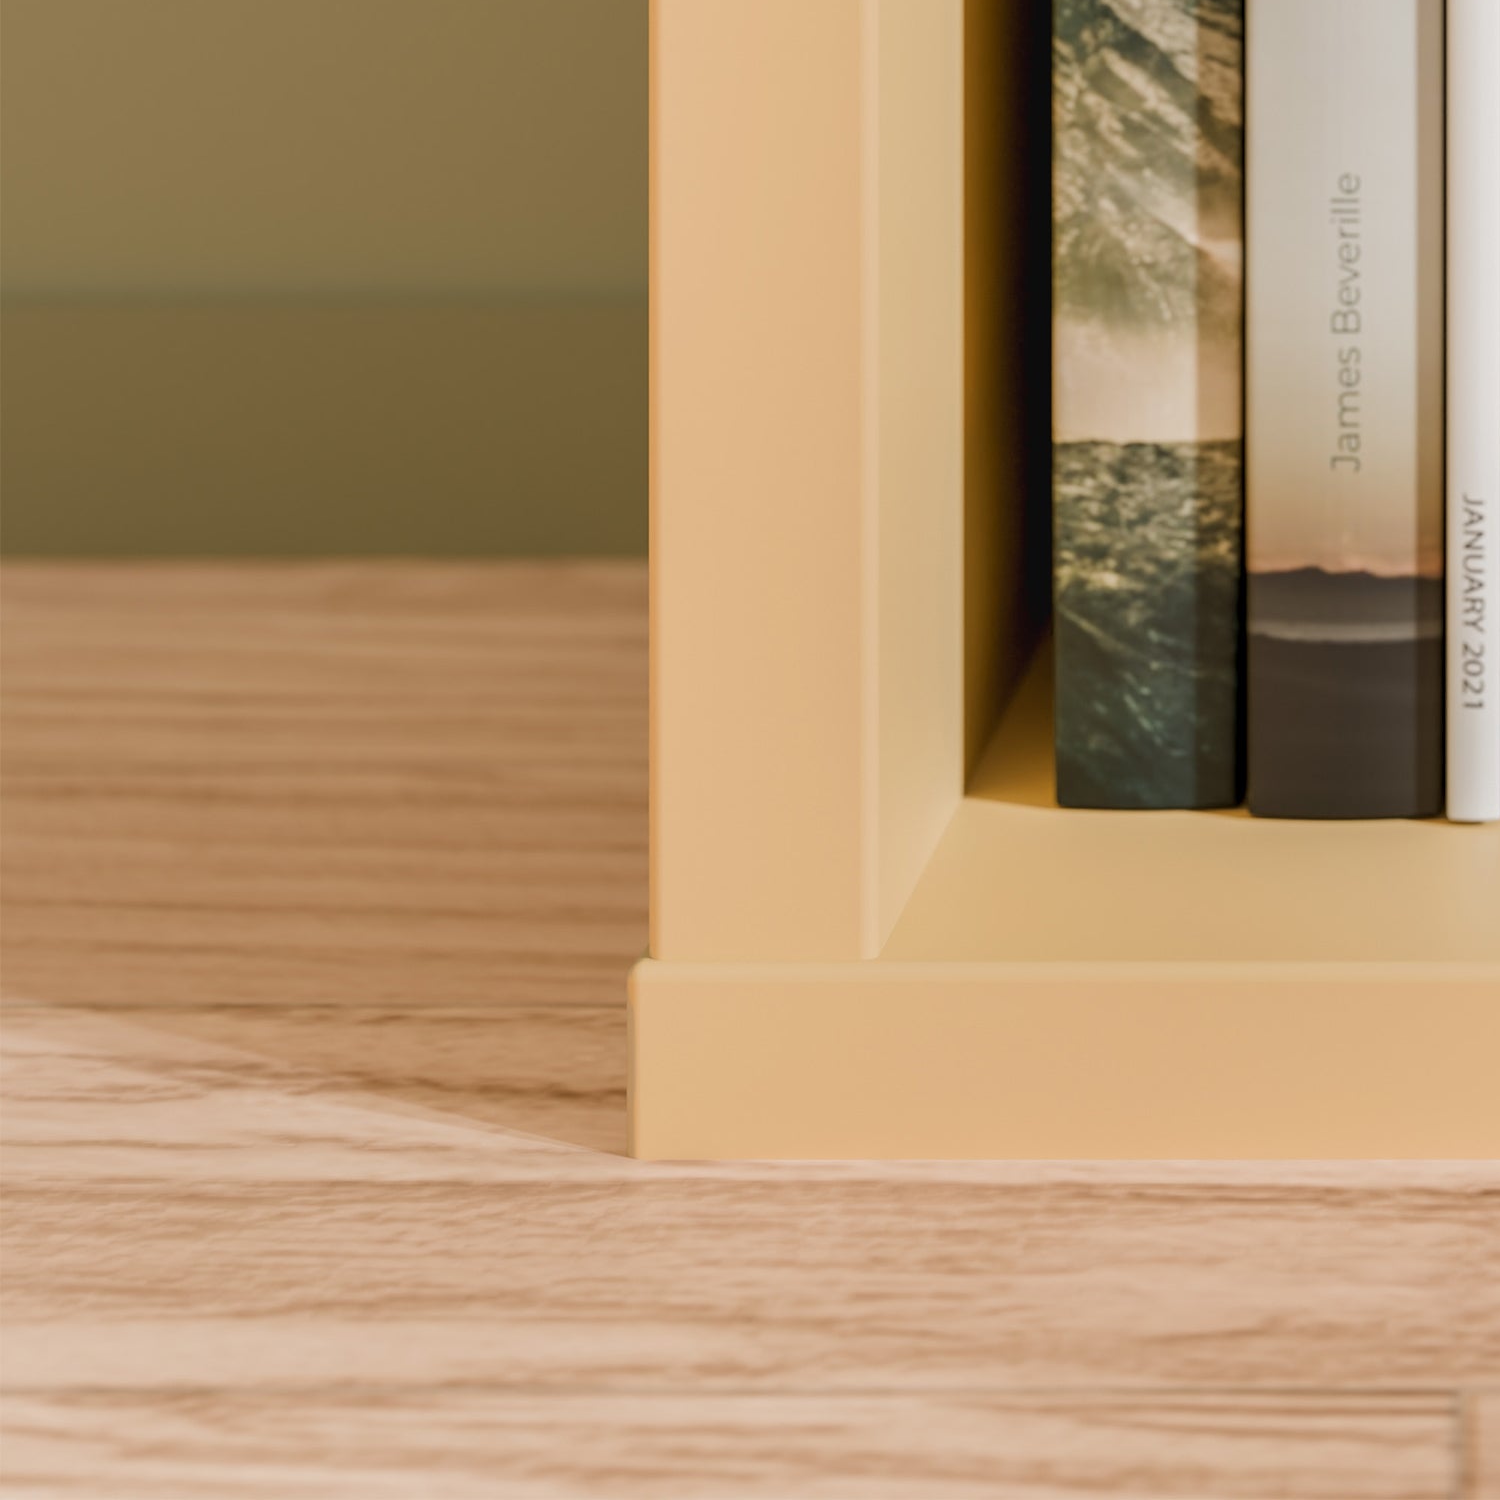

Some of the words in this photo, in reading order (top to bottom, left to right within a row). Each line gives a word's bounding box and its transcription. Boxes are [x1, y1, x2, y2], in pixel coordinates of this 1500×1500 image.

[1330, 172, 1361, 335] Beverille
[1330, 345, 1361, 473] James
[1463, 493, 1485, 636] JANUARY
[1462, 644, 1485, 709] 2021
